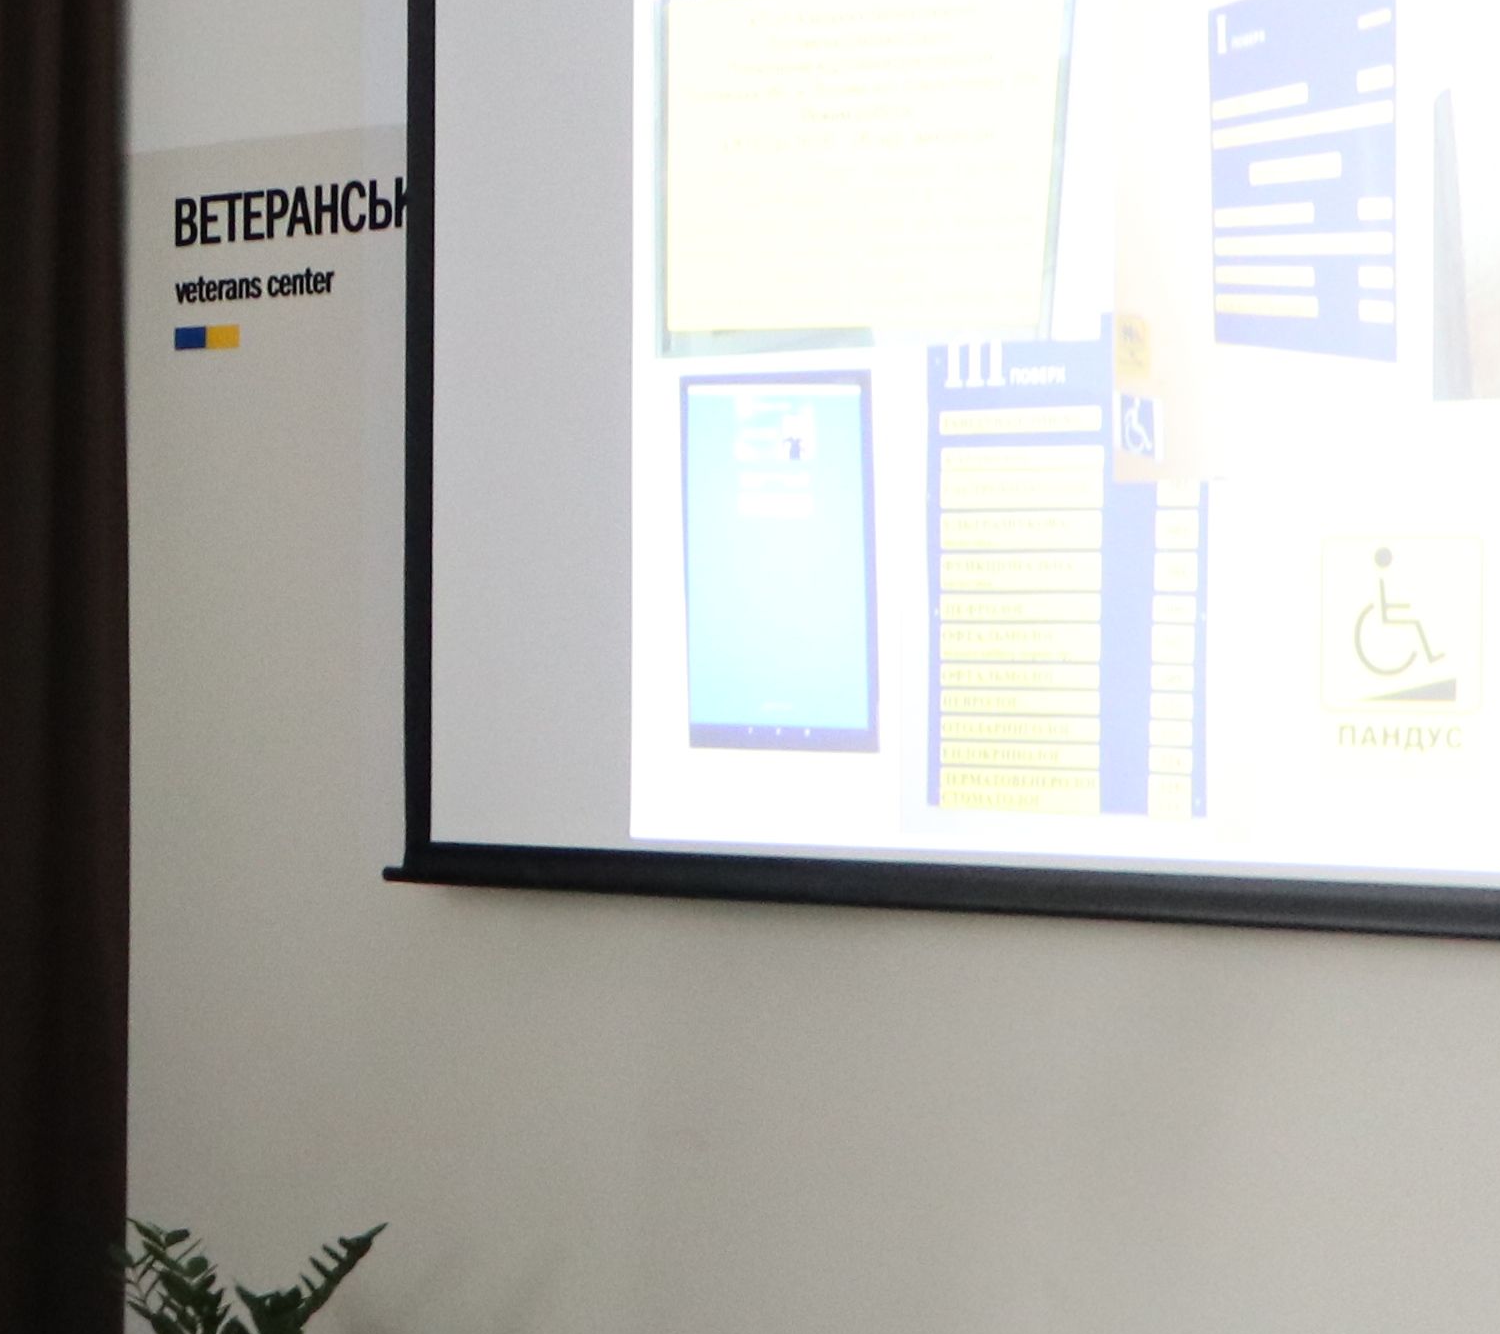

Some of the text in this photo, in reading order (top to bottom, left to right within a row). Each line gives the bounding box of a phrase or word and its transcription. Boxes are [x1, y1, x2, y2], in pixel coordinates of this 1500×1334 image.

[176, 268, 334, 304] veterans center
[1337, 724, 1463, 751] ПАНДУС
